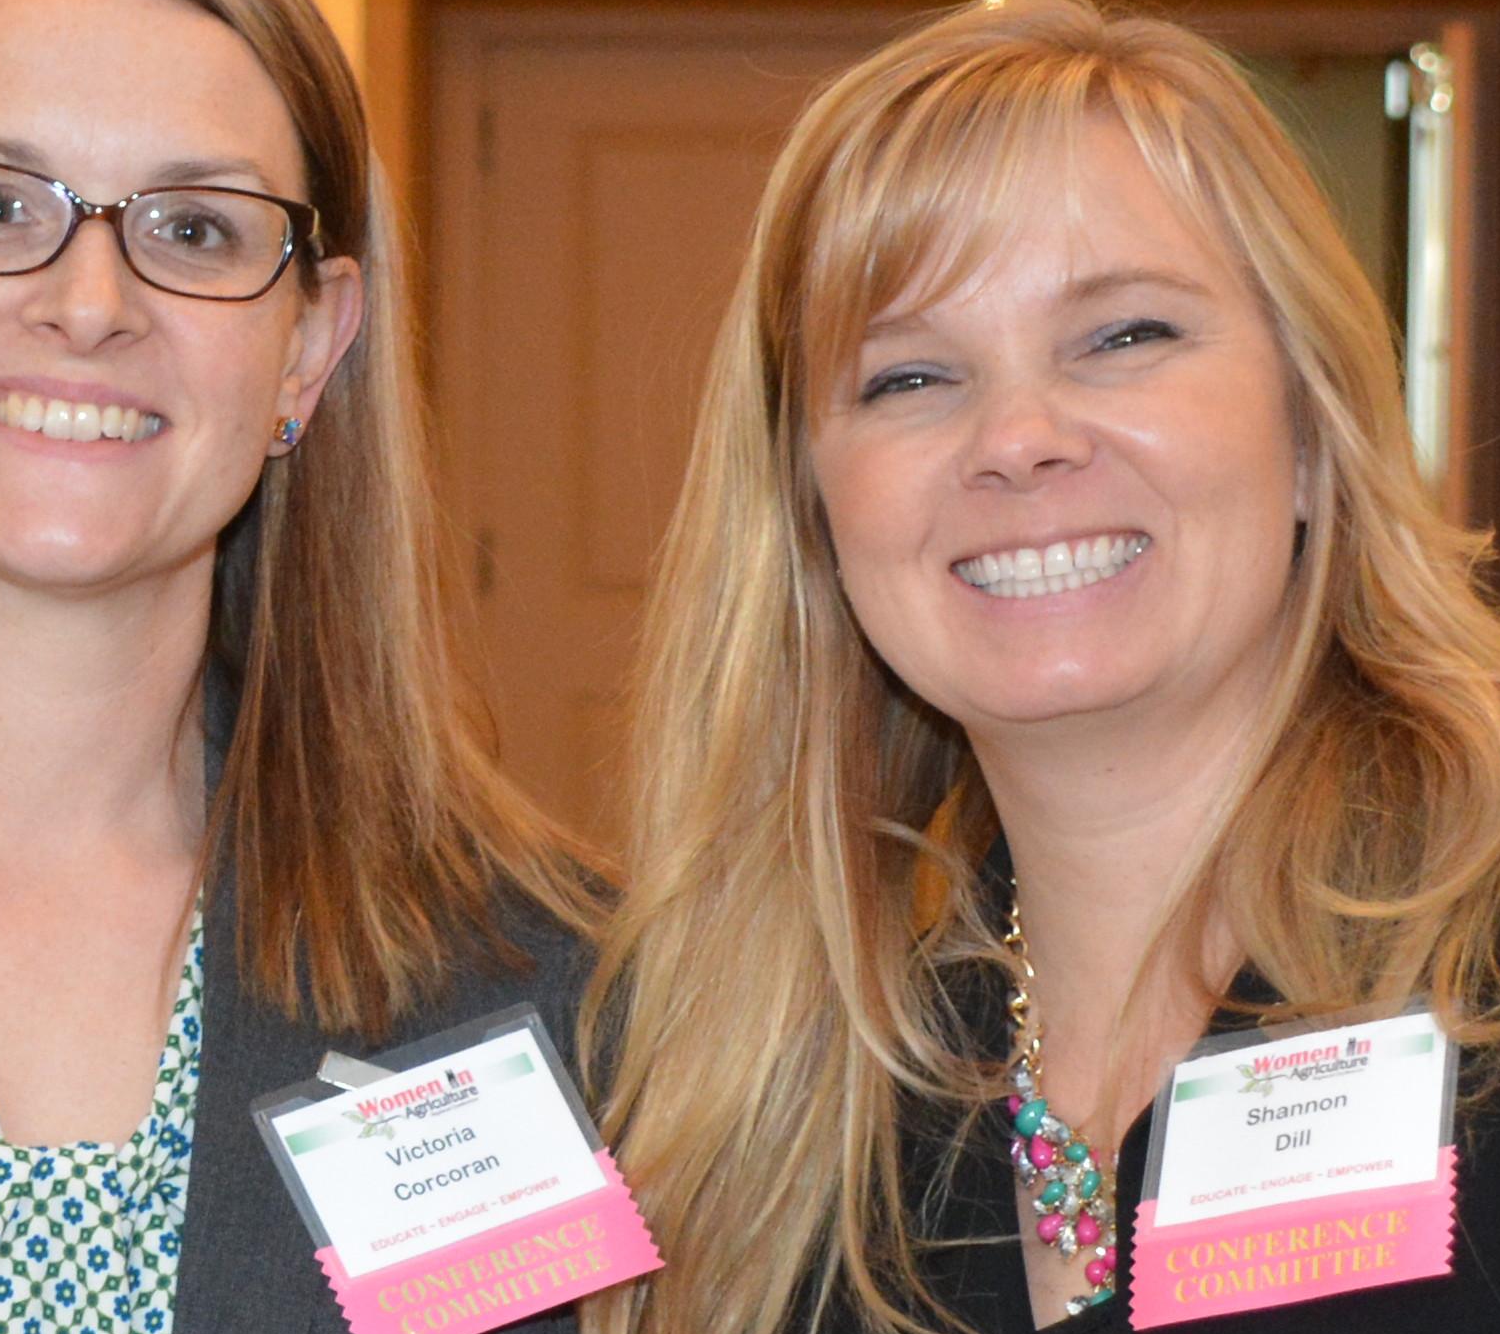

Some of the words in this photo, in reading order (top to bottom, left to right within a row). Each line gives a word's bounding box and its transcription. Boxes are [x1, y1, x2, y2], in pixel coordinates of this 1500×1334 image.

[1253, 1045, 1339, 1075] Women
[1290, 1055, 1368, 1081] Agriculture
[357, 1079, 444, 1119] Women
[405, 1085, 479, 1119] Agriculture
[1246, 1094, 1348, 1126] Shannon
[385, 1127, 477, 1166] Victoria
[1275, 1129, 1311, 1152] Dill
[394, 1154, 500, 1201] Corcoran
[1190, 1185, 1247, 1205] EDUCATE
[1260, 1172, 1313, 1191] ENGAGE
[1327, 1160, 1394, 1178] EMPOWER
[370, 1224, 427, 1252] EDUCATE
[438, 1202, 489, 1228] ENGAGE
[500, 1176, 560, 1205] EMPOWER
[1166, 1210, 1410, 1273] CONFERENCE
[378, 1213, 605, 1312] CONFERENCE
[1175, 1242, 1397, 1303] COMMITTEE
